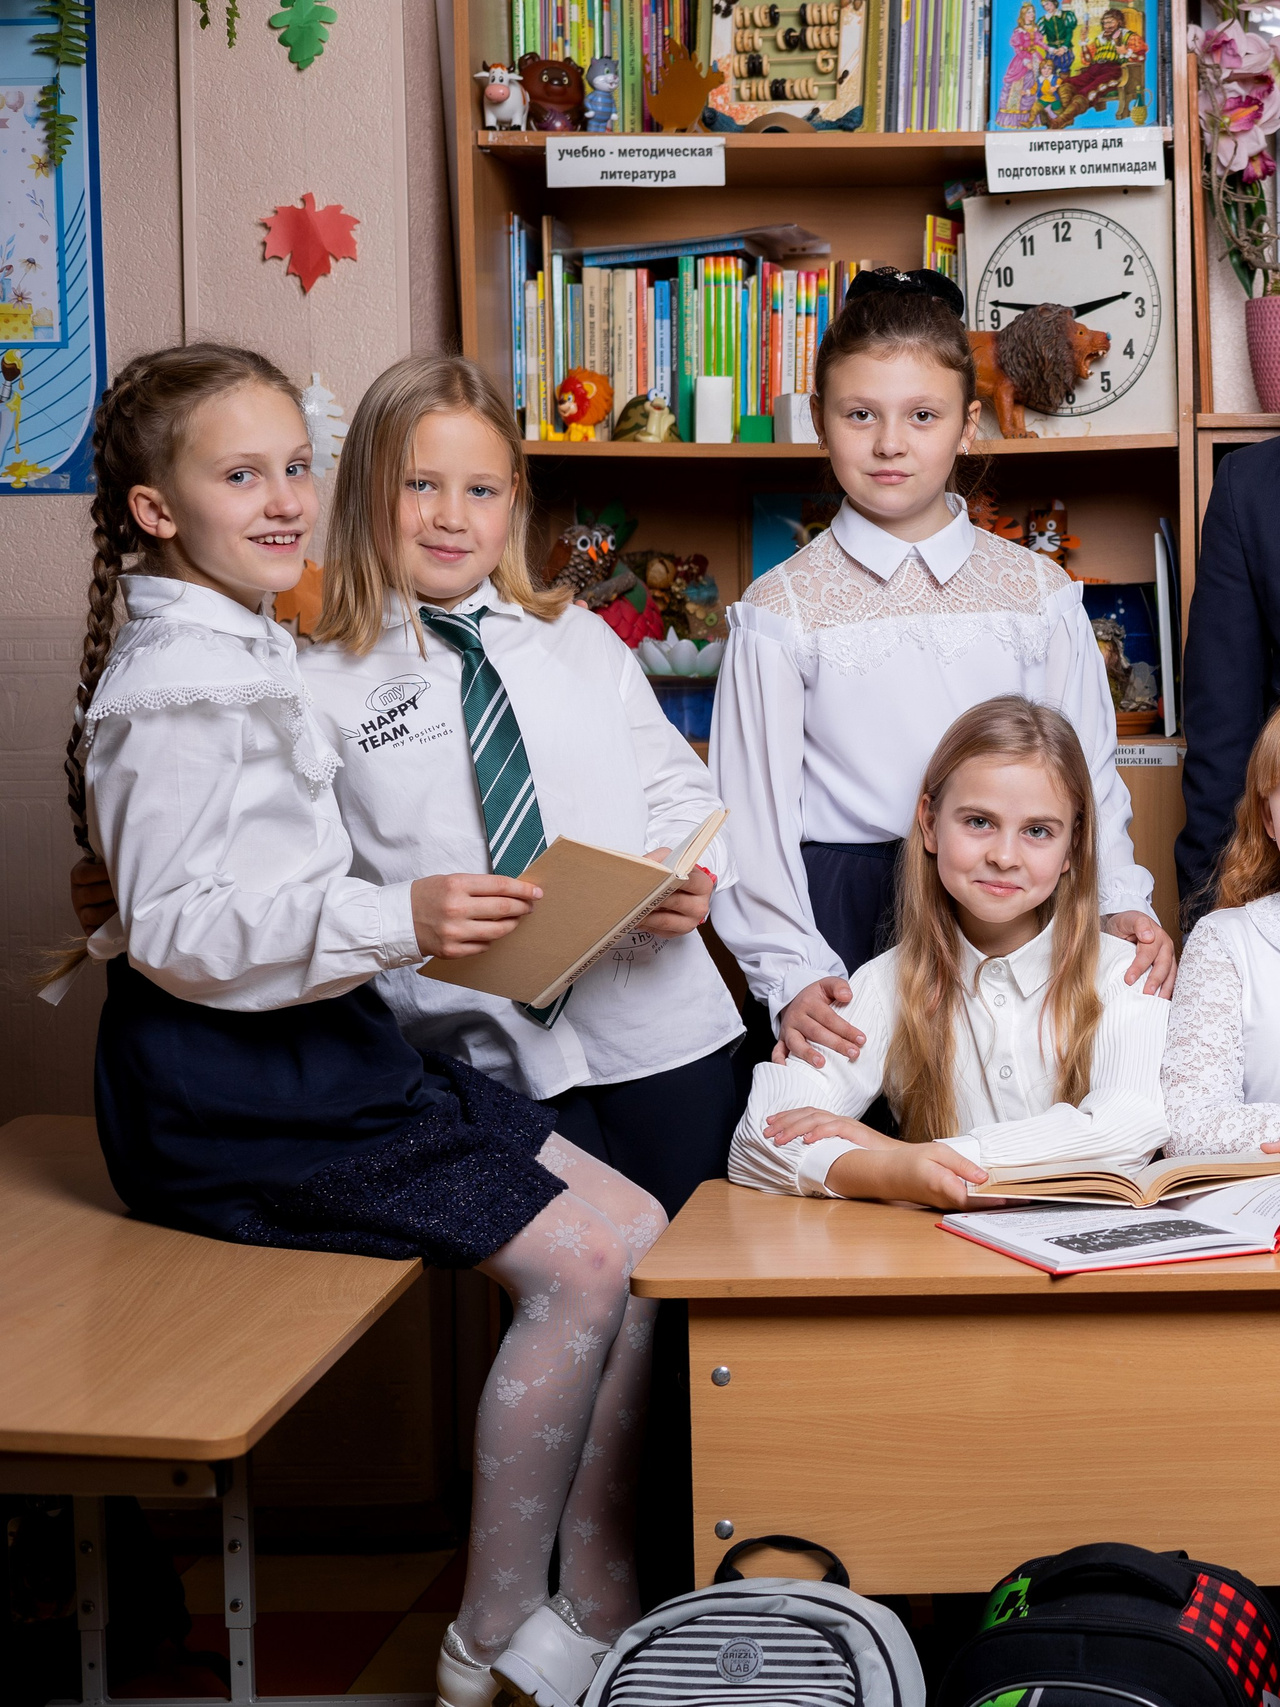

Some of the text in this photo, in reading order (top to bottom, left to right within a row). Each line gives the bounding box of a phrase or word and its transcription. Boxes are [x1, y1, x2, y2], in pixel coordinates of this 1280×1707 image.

[558, 146, 605, 161] учебно
[618, 147, 713, 160] методическая
[1029, 138, 1123, 153] литература для
[600, 170, 676, 182] литература
[998, 161, 1157, 180] подготовки к олимпиадам
[1052, 220, 1072, 243] 12
[1094, 229, 1102, 250] 1
[1020, 235, 1034, 256] 11
[1123, 254, 1134, 276] 2
[995, 266, 1014, 288] 10
[1134, 296, 1146, 318] 3
[990, 308, 1001, 330] 9
[1123, 338, 1135, 360] 4
[1100, 371, 1112, 393] 5
[379, 684, 406, 706] my
[360, 696, 418, 735] HAPPY
[358, 724, 410, 753] TEAM
[392, 722, 447, 749] my positive
[419, 729, 454, 745] friends
[564, 940, 616, 985] ЗАНИМАТЕЛЬНО
[620, 906, 653, 935] РУССКОМ
[650, 886, 676, 907] ЯЗЫКЕ
[730, 1664, 750, 1672] LAB
